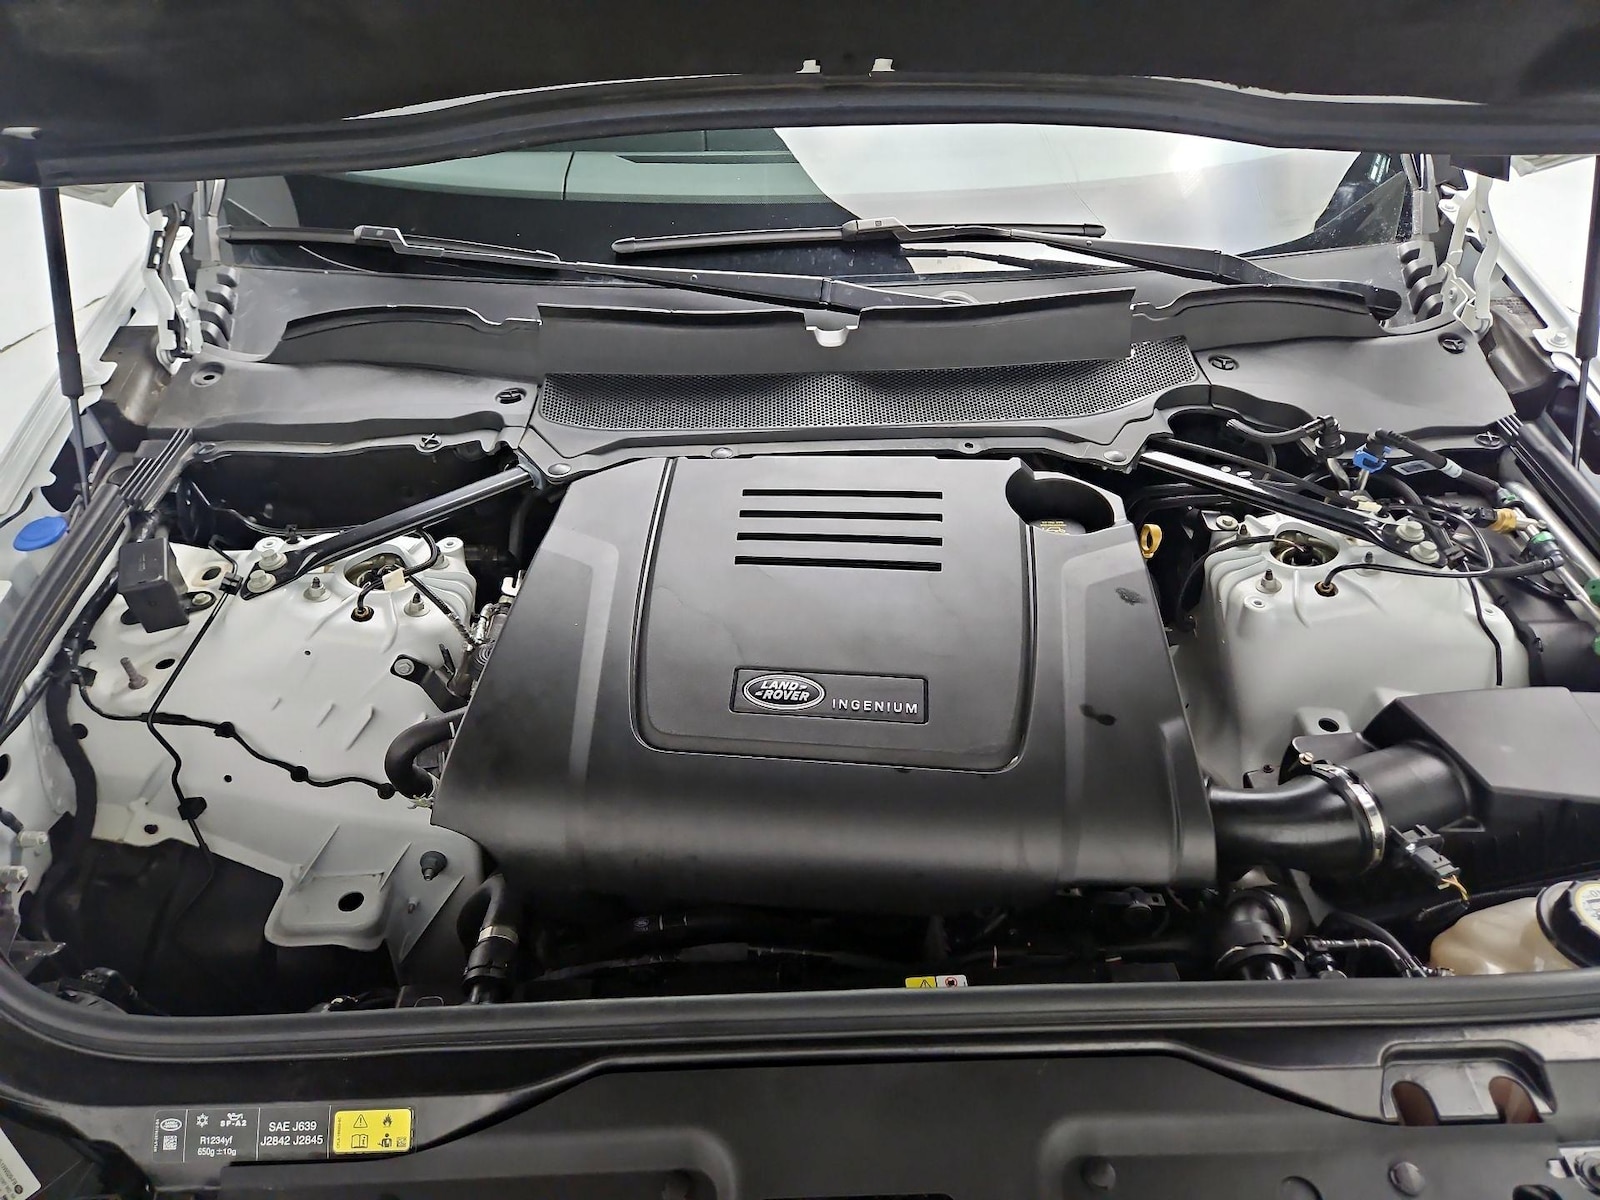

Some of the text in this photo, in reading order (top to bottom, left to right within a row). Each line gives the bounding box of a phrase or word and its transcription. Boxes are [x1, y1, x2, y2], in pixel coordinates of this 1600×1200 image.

[760, 680, 799, 691] LAND
[761, 689, 810, 701] ROVER
[831, 698, 918, 714] INGENIUM
[268, 1121, 317, 1132] SAE J639
[200, 1135, 233, 1146] R1234yf
[260, 1134, 324, 1146] J2842 J2845
[197, 1147, 237, 1158] 650g ±10g
